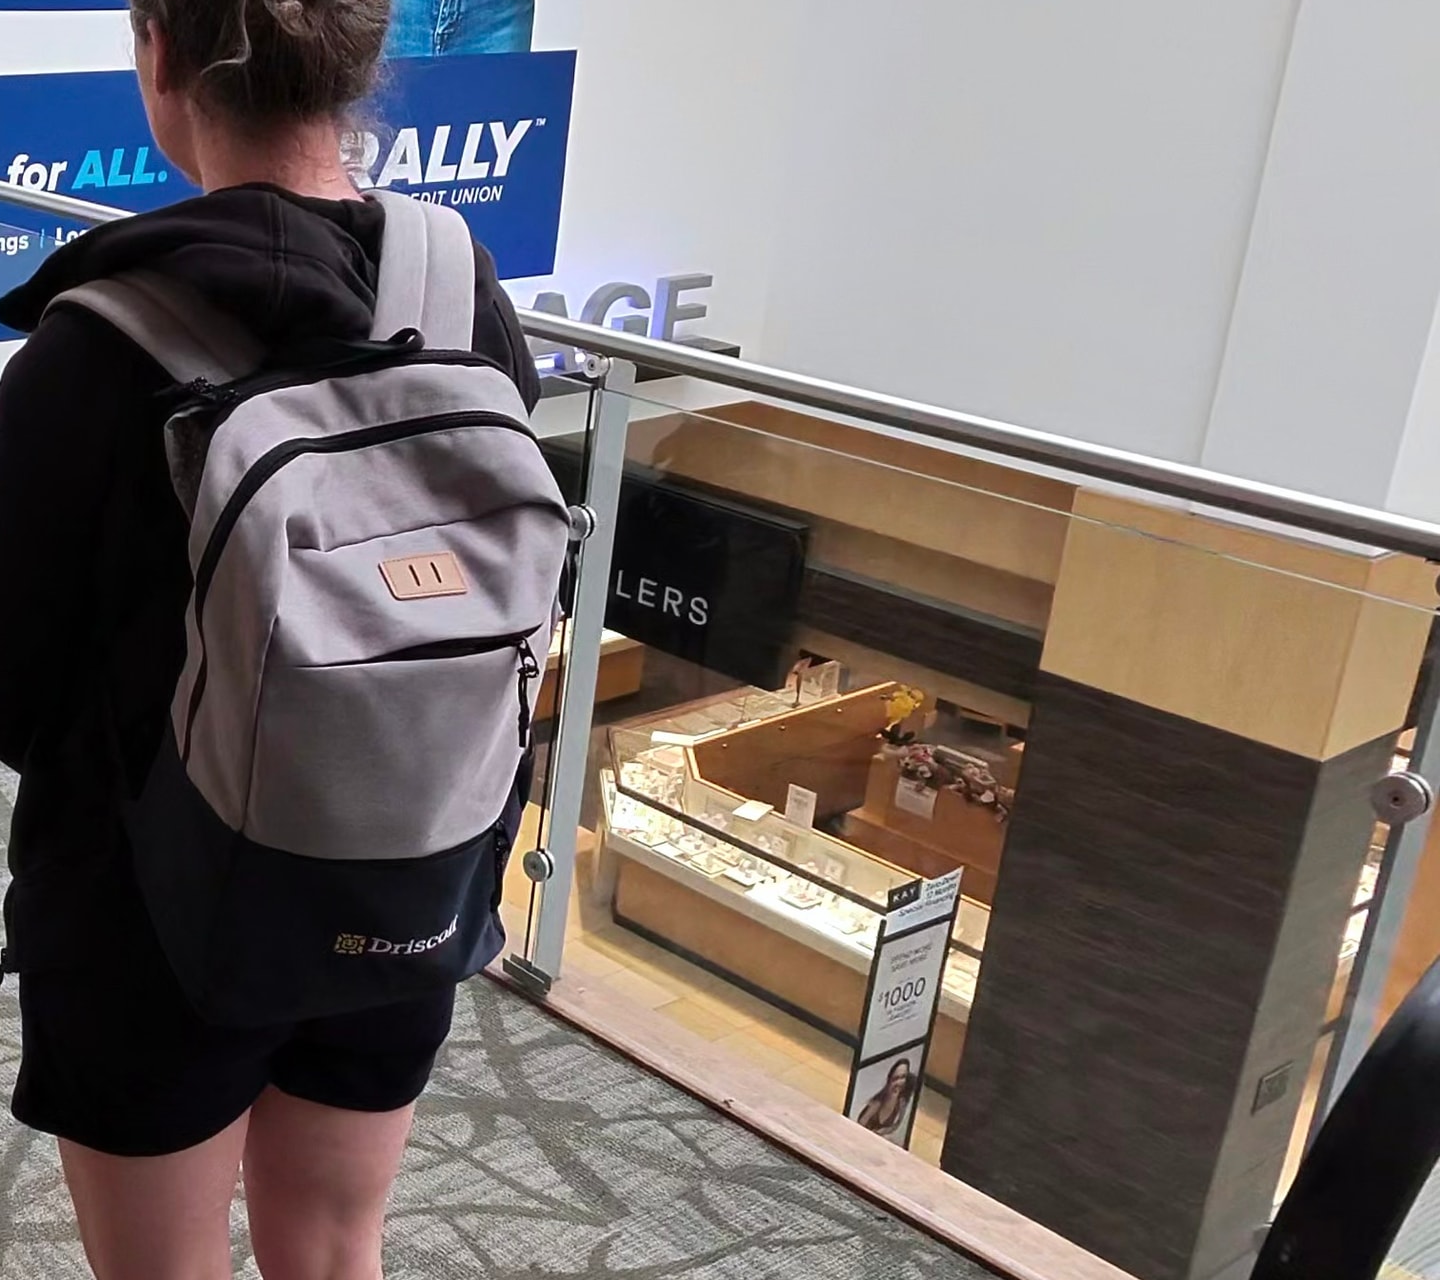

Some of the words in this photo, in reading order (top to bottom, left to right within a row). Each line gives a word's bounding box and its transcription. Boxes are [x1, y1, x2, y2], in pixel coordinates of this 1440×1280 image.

[7, 153, 67, 192] for
[71, 146, 168, 190] ALL.
[451, 185, 503, 205] UNION
[616, 570, 708, 625] LERS
[893, 887, 916, 903] KAY
[878, 977, 926, 1009] $1000
